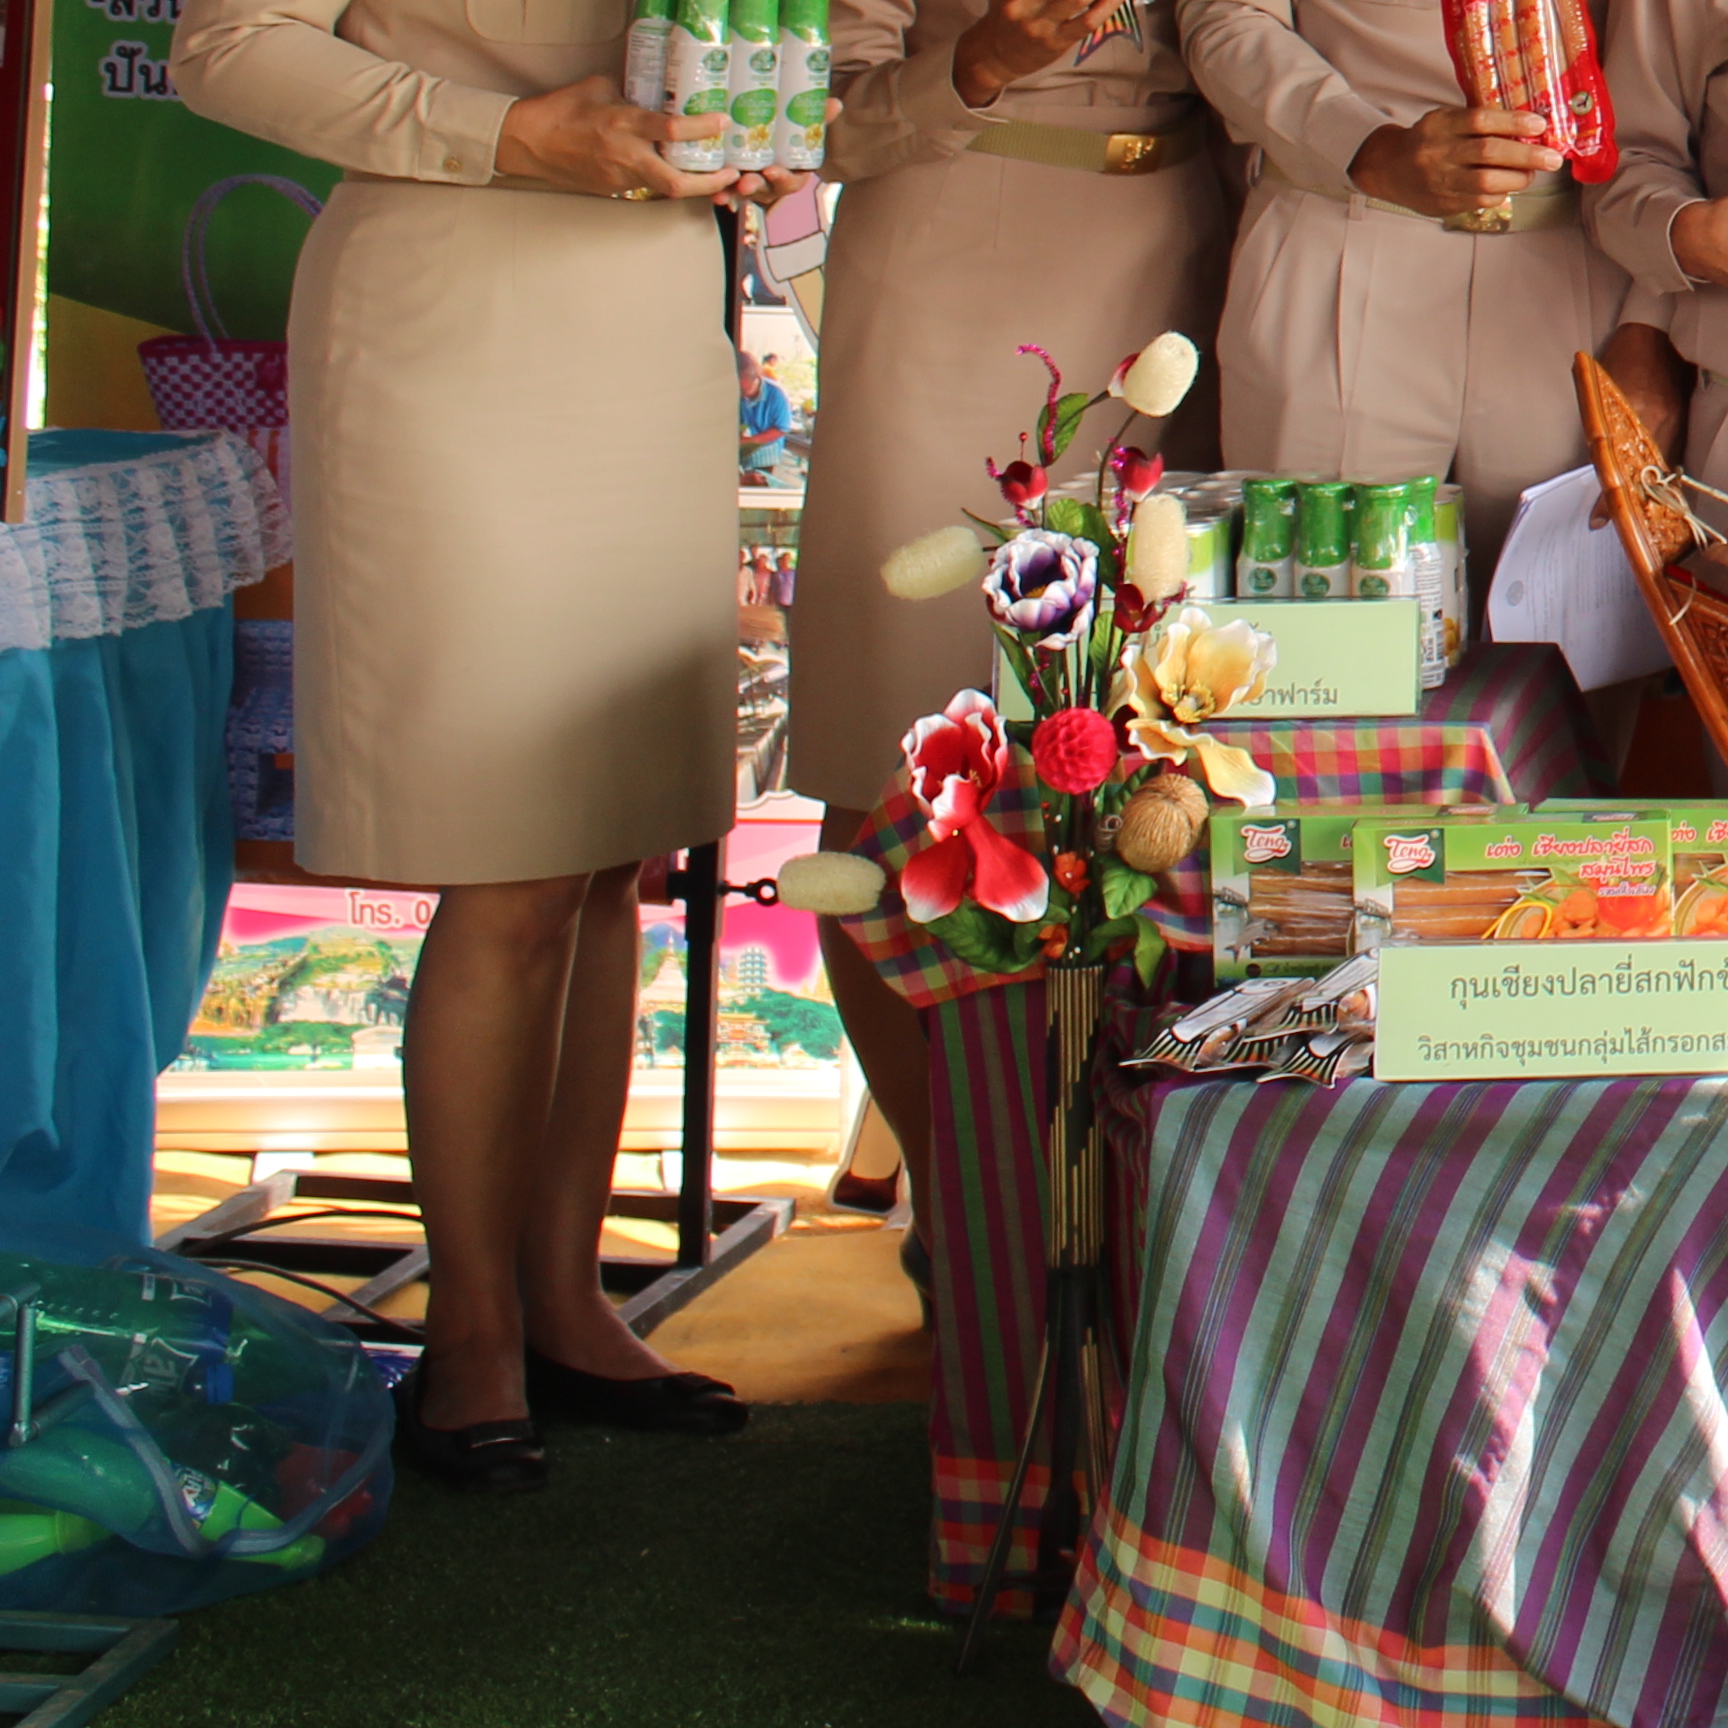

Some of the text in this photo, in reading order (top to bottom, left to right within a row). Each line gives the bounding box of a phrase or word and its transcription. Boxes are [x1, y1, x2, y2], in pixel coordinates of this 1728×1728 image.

[1671, 821, 1697, 843] ต่ง
[1383, 833, 1436, 874] Teng
[1579, 855, 1656, 884] สมุนไพร
[346, 889, 400, 926] โทร.
